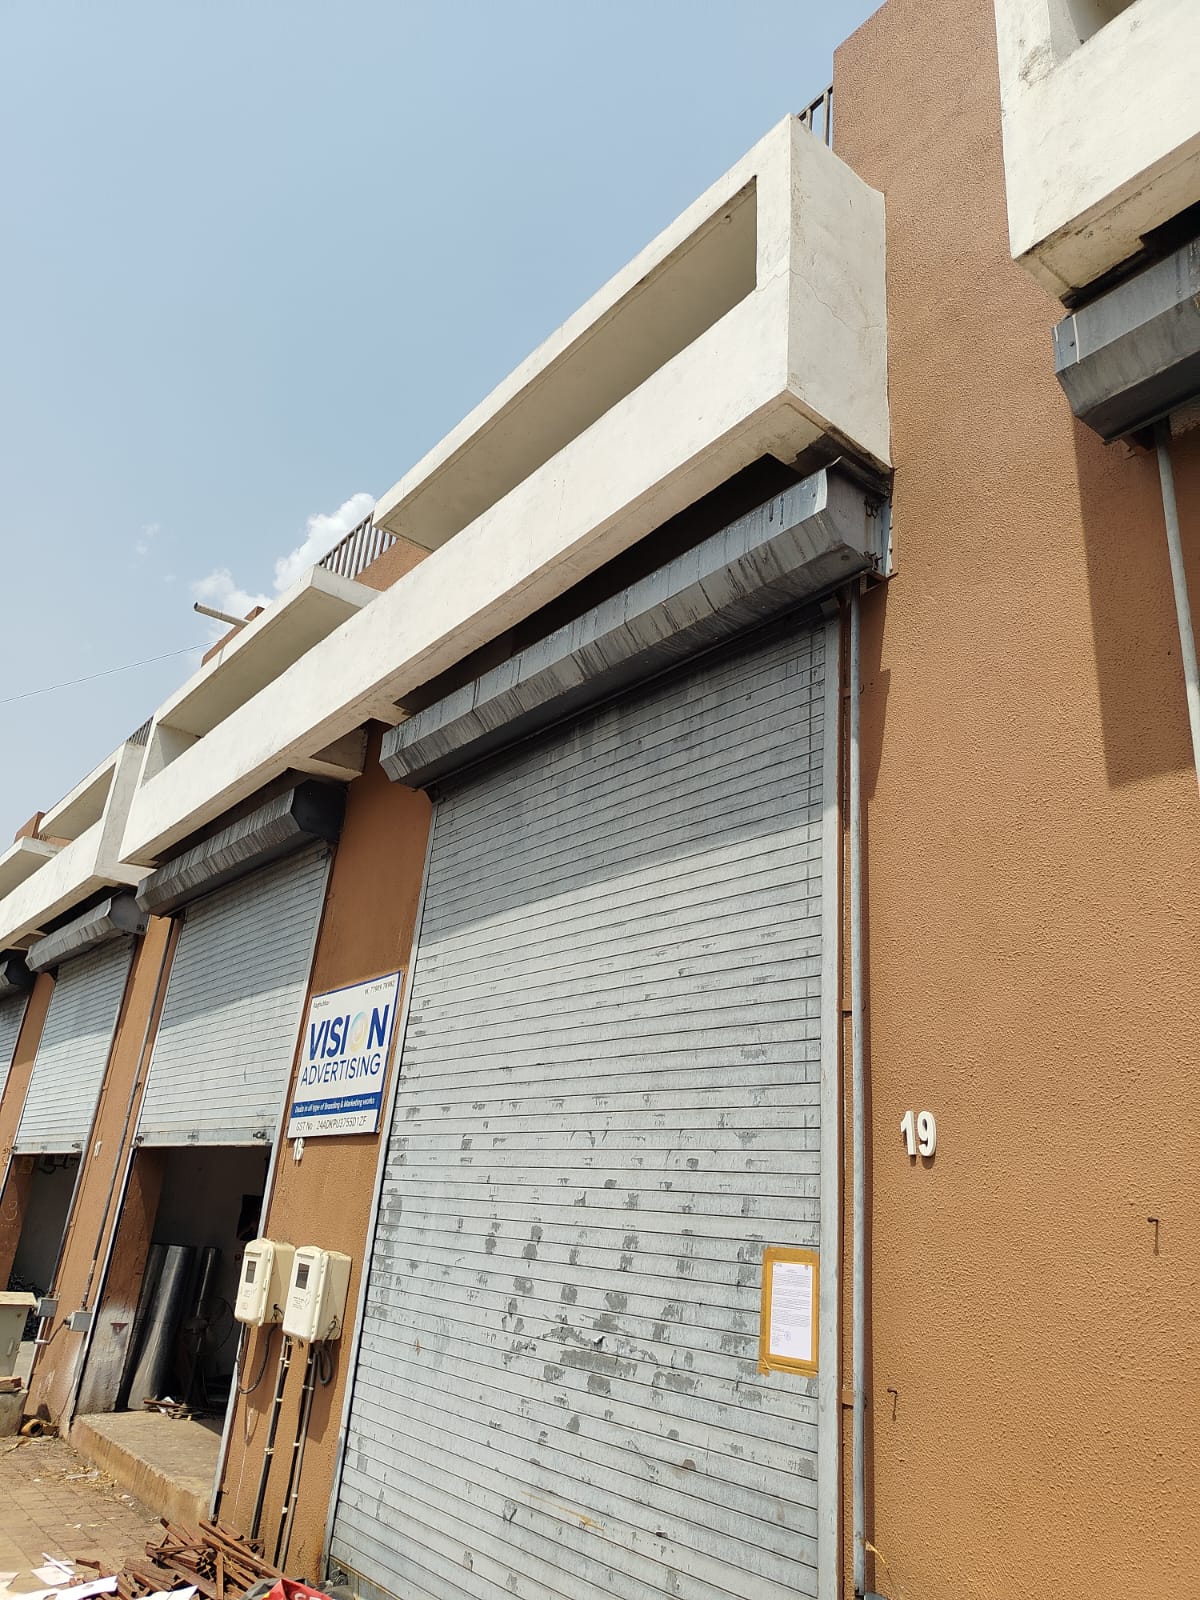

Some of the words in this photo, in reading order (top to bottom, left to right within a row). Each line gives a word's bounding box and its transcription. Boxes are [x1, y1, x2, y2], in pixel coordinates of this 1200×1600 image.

[309, 1004, 390, 1061] VISION
[301, 1053, 381, 1085] ADVERTISING
[900, 1110, 937, 1157] 19
